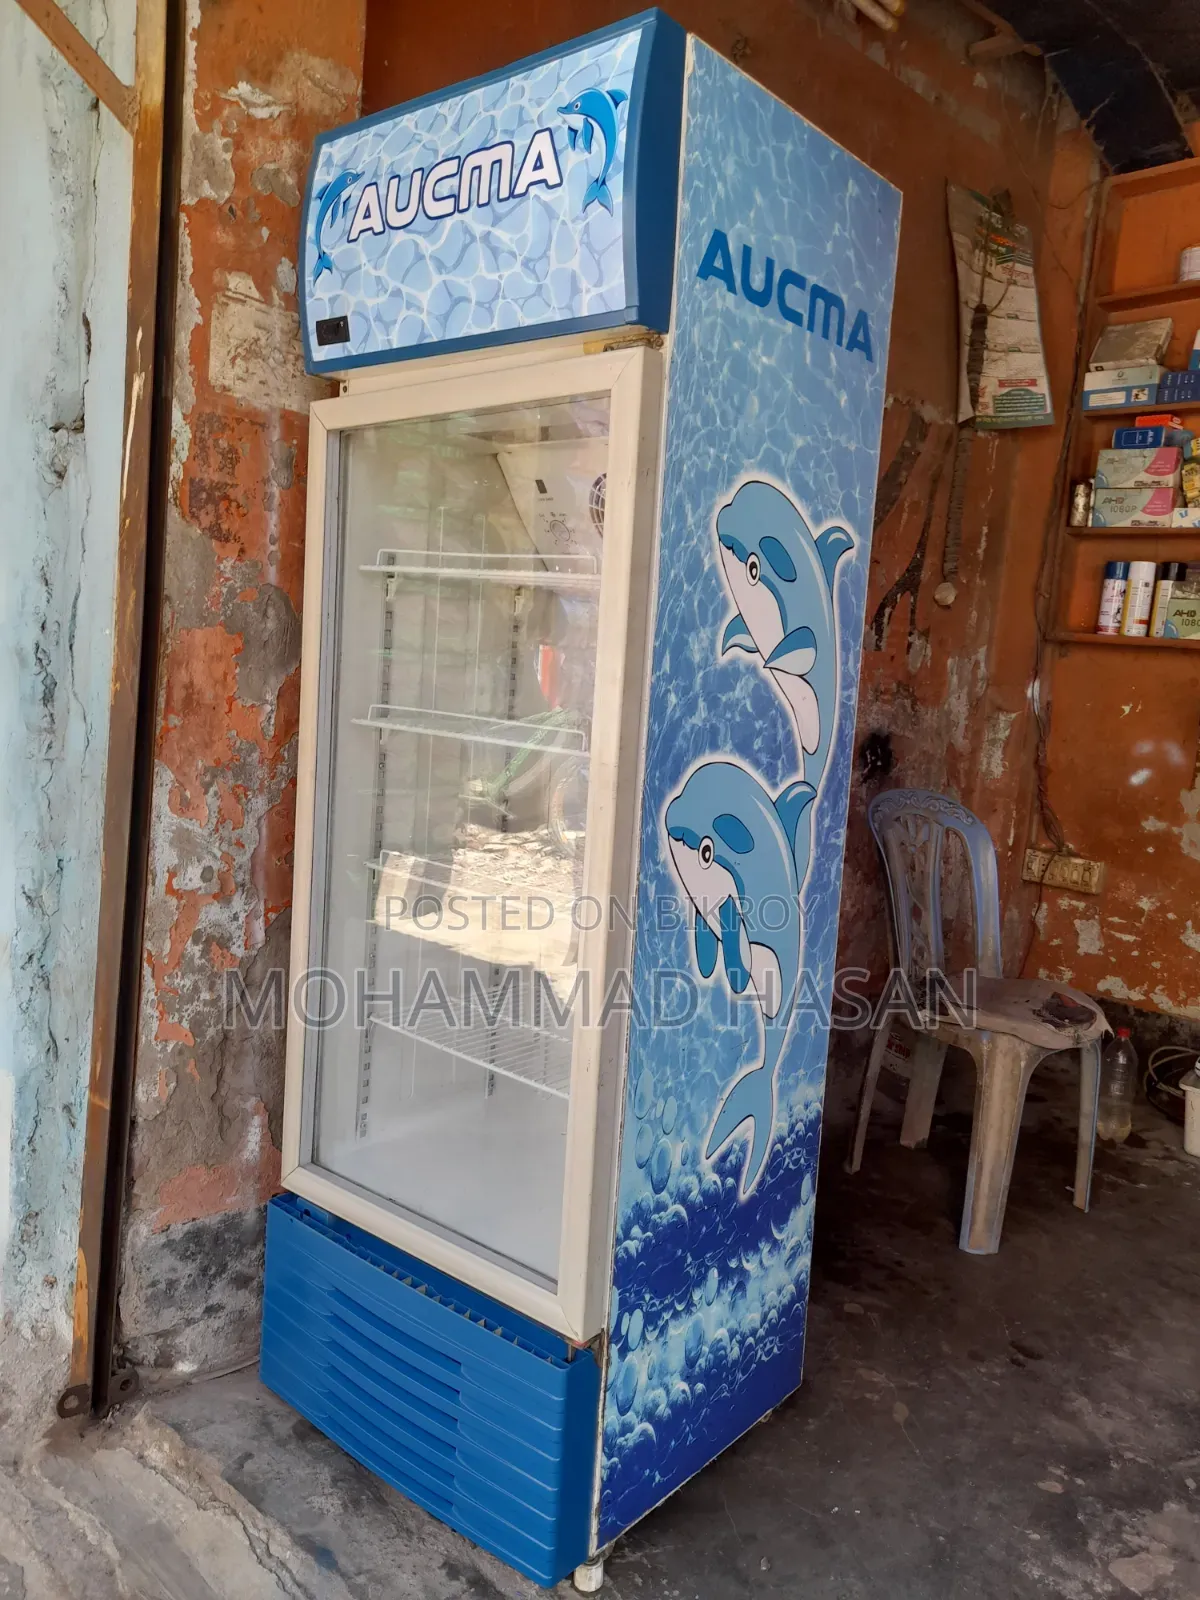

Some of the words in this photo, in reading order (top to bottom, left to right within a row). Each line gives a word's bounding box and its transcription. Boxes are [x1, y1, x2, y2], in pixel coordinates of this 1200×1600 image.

[347, 128, 563, 242] AUCMA
[696, 228, 874, 363] AUCMA
[1172, 609, 1196, 617] AHD
